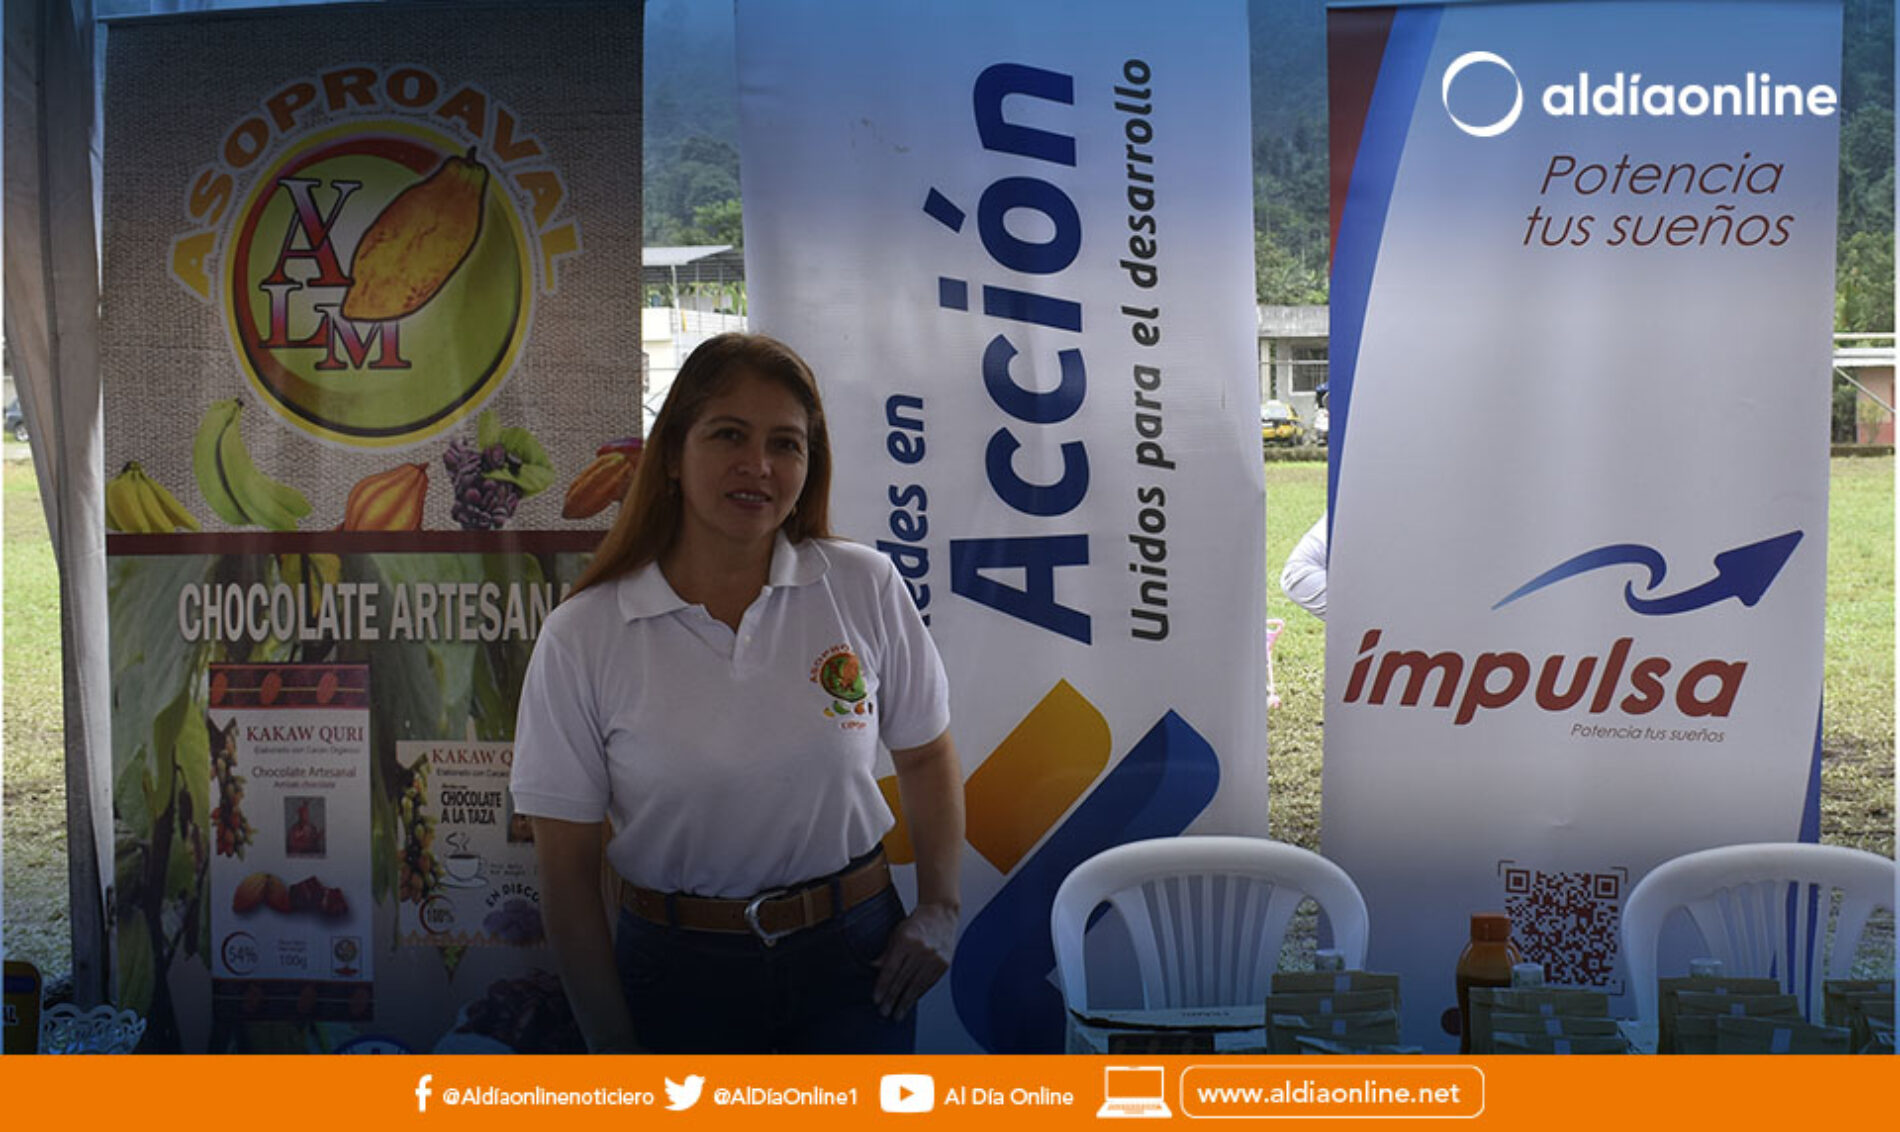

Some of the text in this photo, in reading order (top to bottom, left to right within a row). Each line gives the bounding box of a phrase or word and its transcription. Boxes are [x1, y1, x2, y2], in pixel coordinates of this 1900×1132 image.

[168, 66, 582, 296] ASOPROAVAL
[1540, 152, 1784, 195] Potencia
[1522, 205, 1795, 246] tus sueños
[924, 62, 1092, 646] Acción
[1114, 58, 1175, 641] Unidos para el desarrollo
[876, 393, 931, 628] edes en
[178, 583, 571, 642] CHOCOLATE ARTESAN
[246, 726, 363, 744] KAKAW QURI
[1570, 723, 1726, 743] Potencia tus sueños
[432, 749, 513, 767] KAKAW Q
[252, 766, 357, 778] Chocolate Artesanal
[441, 790, 502, 807] CHOCOLATE
[441, 808, 496, 825] A LA TAZA
[228, 945, 259, 965] 54%
[279, 954, 308, 970] 100g
